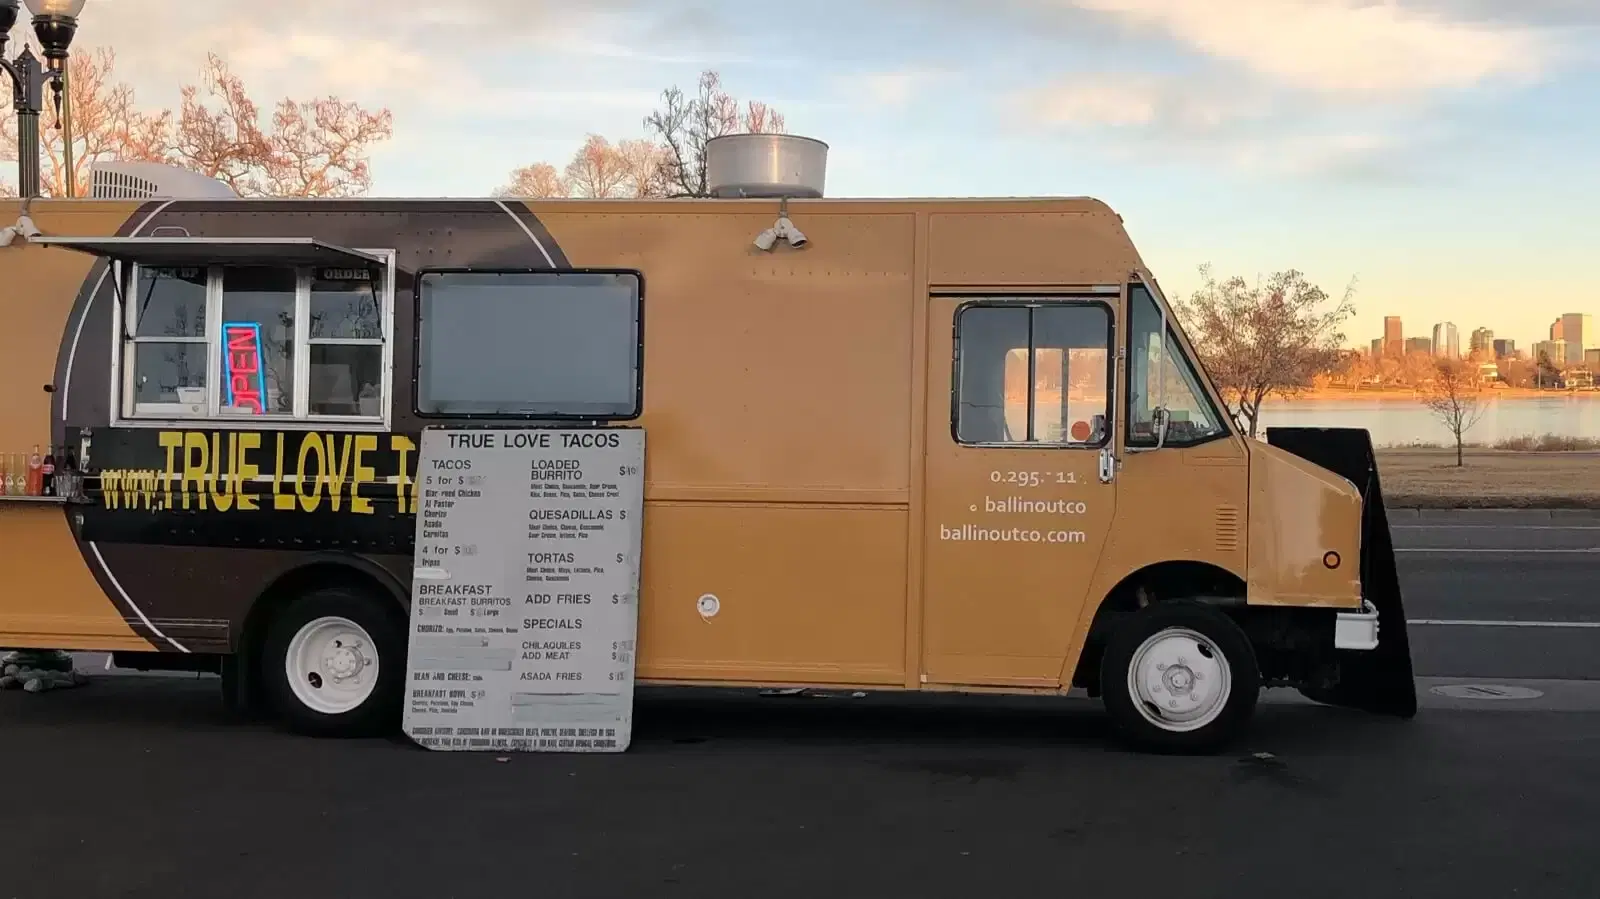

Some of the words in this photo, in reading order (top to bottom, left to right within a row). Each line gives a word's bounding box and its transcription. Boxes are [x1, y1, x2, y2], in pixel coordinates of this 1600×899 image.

[448, 434, 494, 448] TRUE
[504, 434, 550, 448] LOVE
[560, 434, 619, 447] TACOS
[432, 460, 471, 469] TACOS
[532, 460, 579, 469] LOADED
[273, 432, 377, 514] LOVE
[391, 435, 416, 514] T
[532, 470, 582, 480] BURRITO
[427, 476, 432, 484] 5
[438, 476, 452, 484] for
[985, 496, 1087, 514] ballinoutco
[529, 510, 612, 520] QUESADILLAS
[940, 524, 1086, 543] ballinoutco.com
[423, 546, 427, 554] 4
[435, 546, 448, 554] for
[528, 553, 574, 563] TORTAS
[420, 585, 492, 594] BREAKFAST
[419, 598, 466, 606] BREAKFAST
[525, 594, 551, 604] ADD
[557, 594, 590, 604] FRIES
[524, 619, 582, 629] SPECIALS
[520, 672, 551, 680] ASADA
